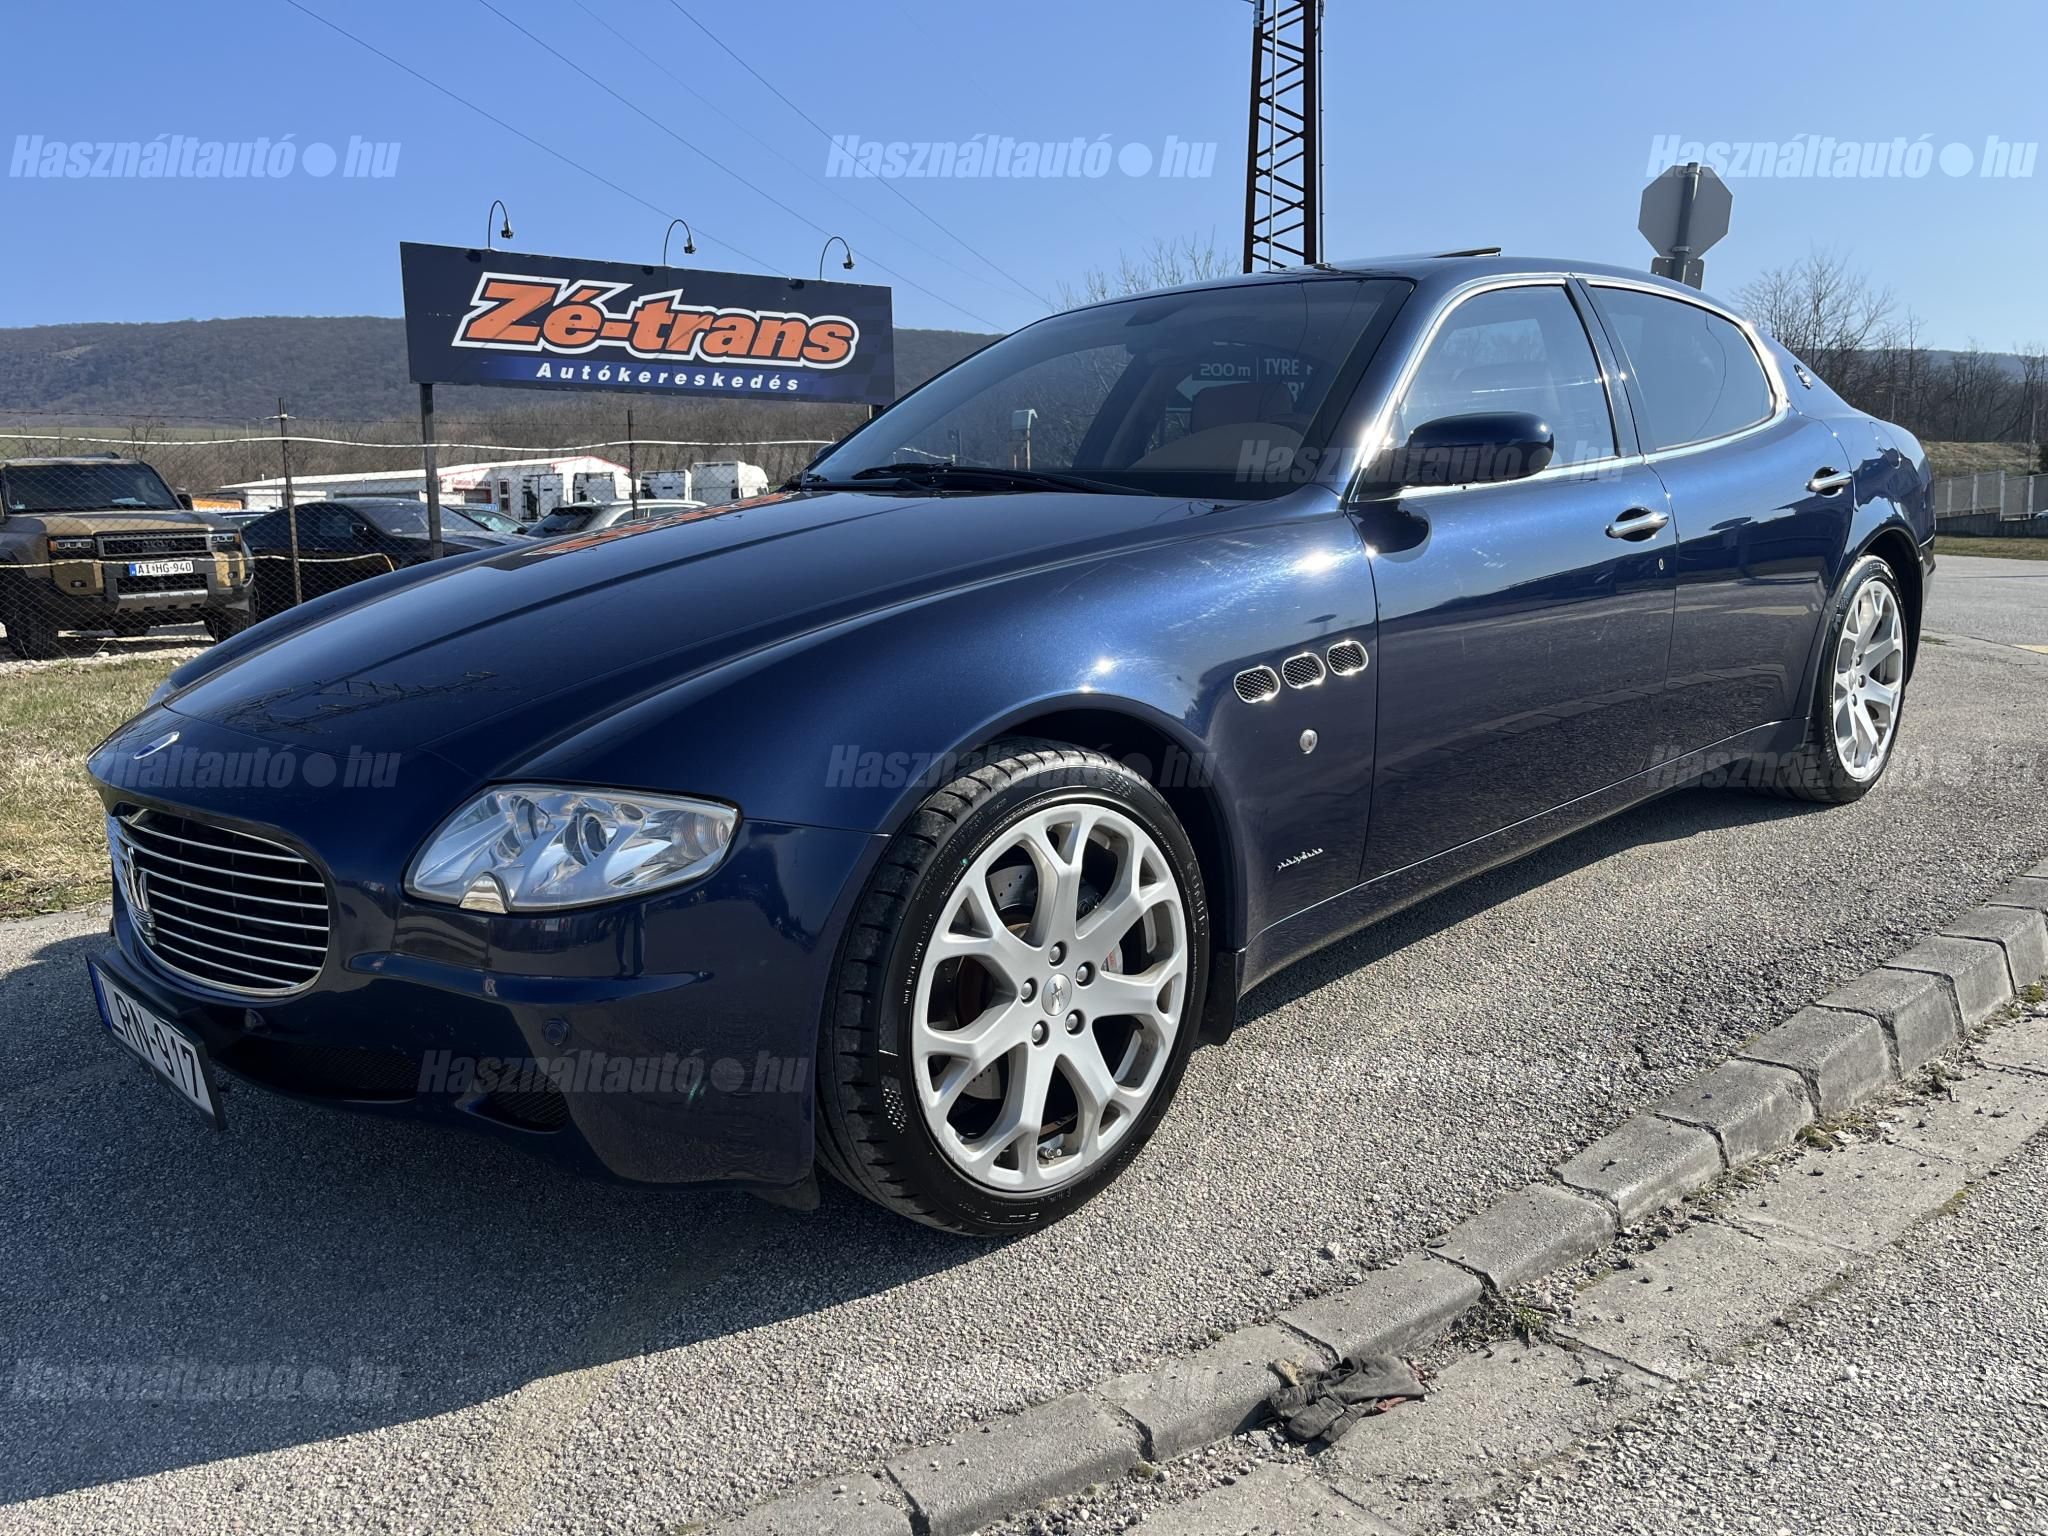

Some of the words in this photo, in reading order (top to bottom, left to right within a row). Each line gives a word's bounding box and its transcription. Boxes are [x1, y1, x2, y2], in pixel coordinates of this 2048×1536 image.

[454, 273, 859, 367] Zé-trans
[536, 361, 799, 391] Autókereskedés
[1200, 362, 1235, 377] 200
[1238, 365, 1251, 377] m
[1263, 358, 1300, 376] TYRE
[100, 978, 199, 1099] LRN-917
